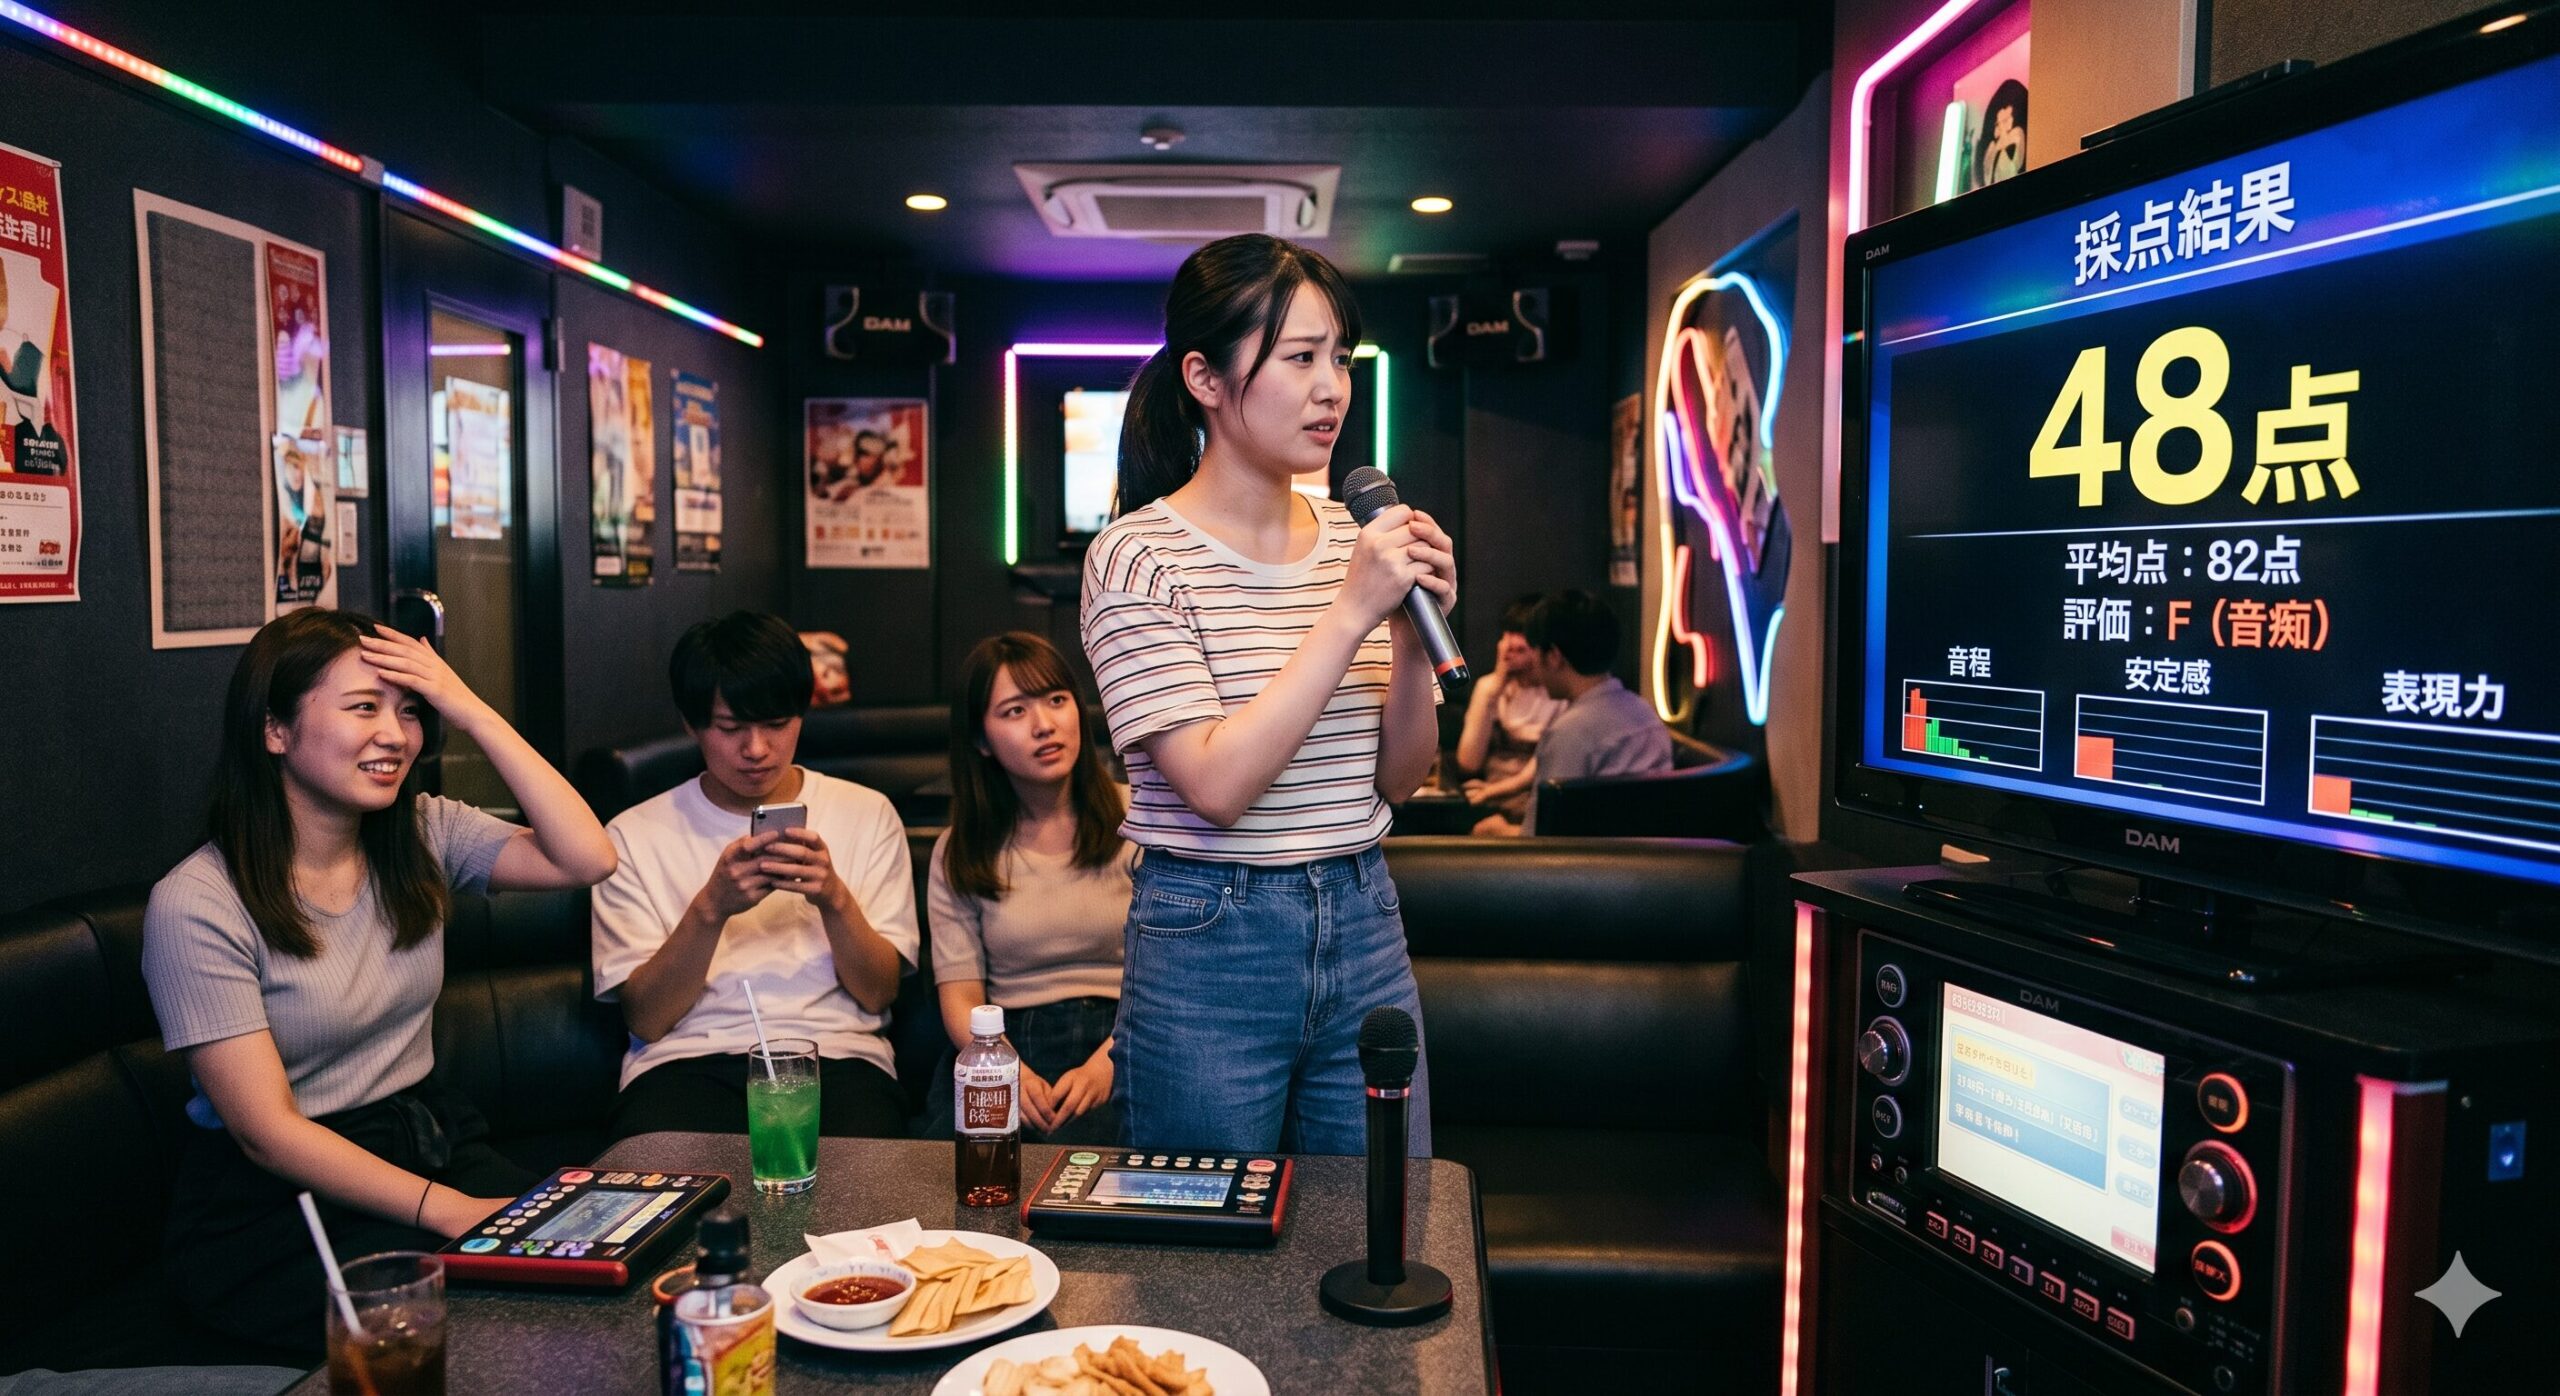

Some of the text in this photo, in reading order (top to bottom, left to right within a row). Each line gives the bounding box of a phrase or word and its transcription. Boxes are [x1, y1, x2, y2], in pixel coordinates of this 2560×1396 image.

[2073, 161, 2295, 286] 採点結果
[1865, 244, 1890, 260] DAM
[2029, 327, 2360, 507] 48点
[1947, 645, 1991, 678] 音程
[2124, 656, 2211, 696] 安定感
[2381, 669, 2505, 721] 表現力
[2125, 828, 2181, 855] DAM
[2019, 988, 2060, 1014] DAM
